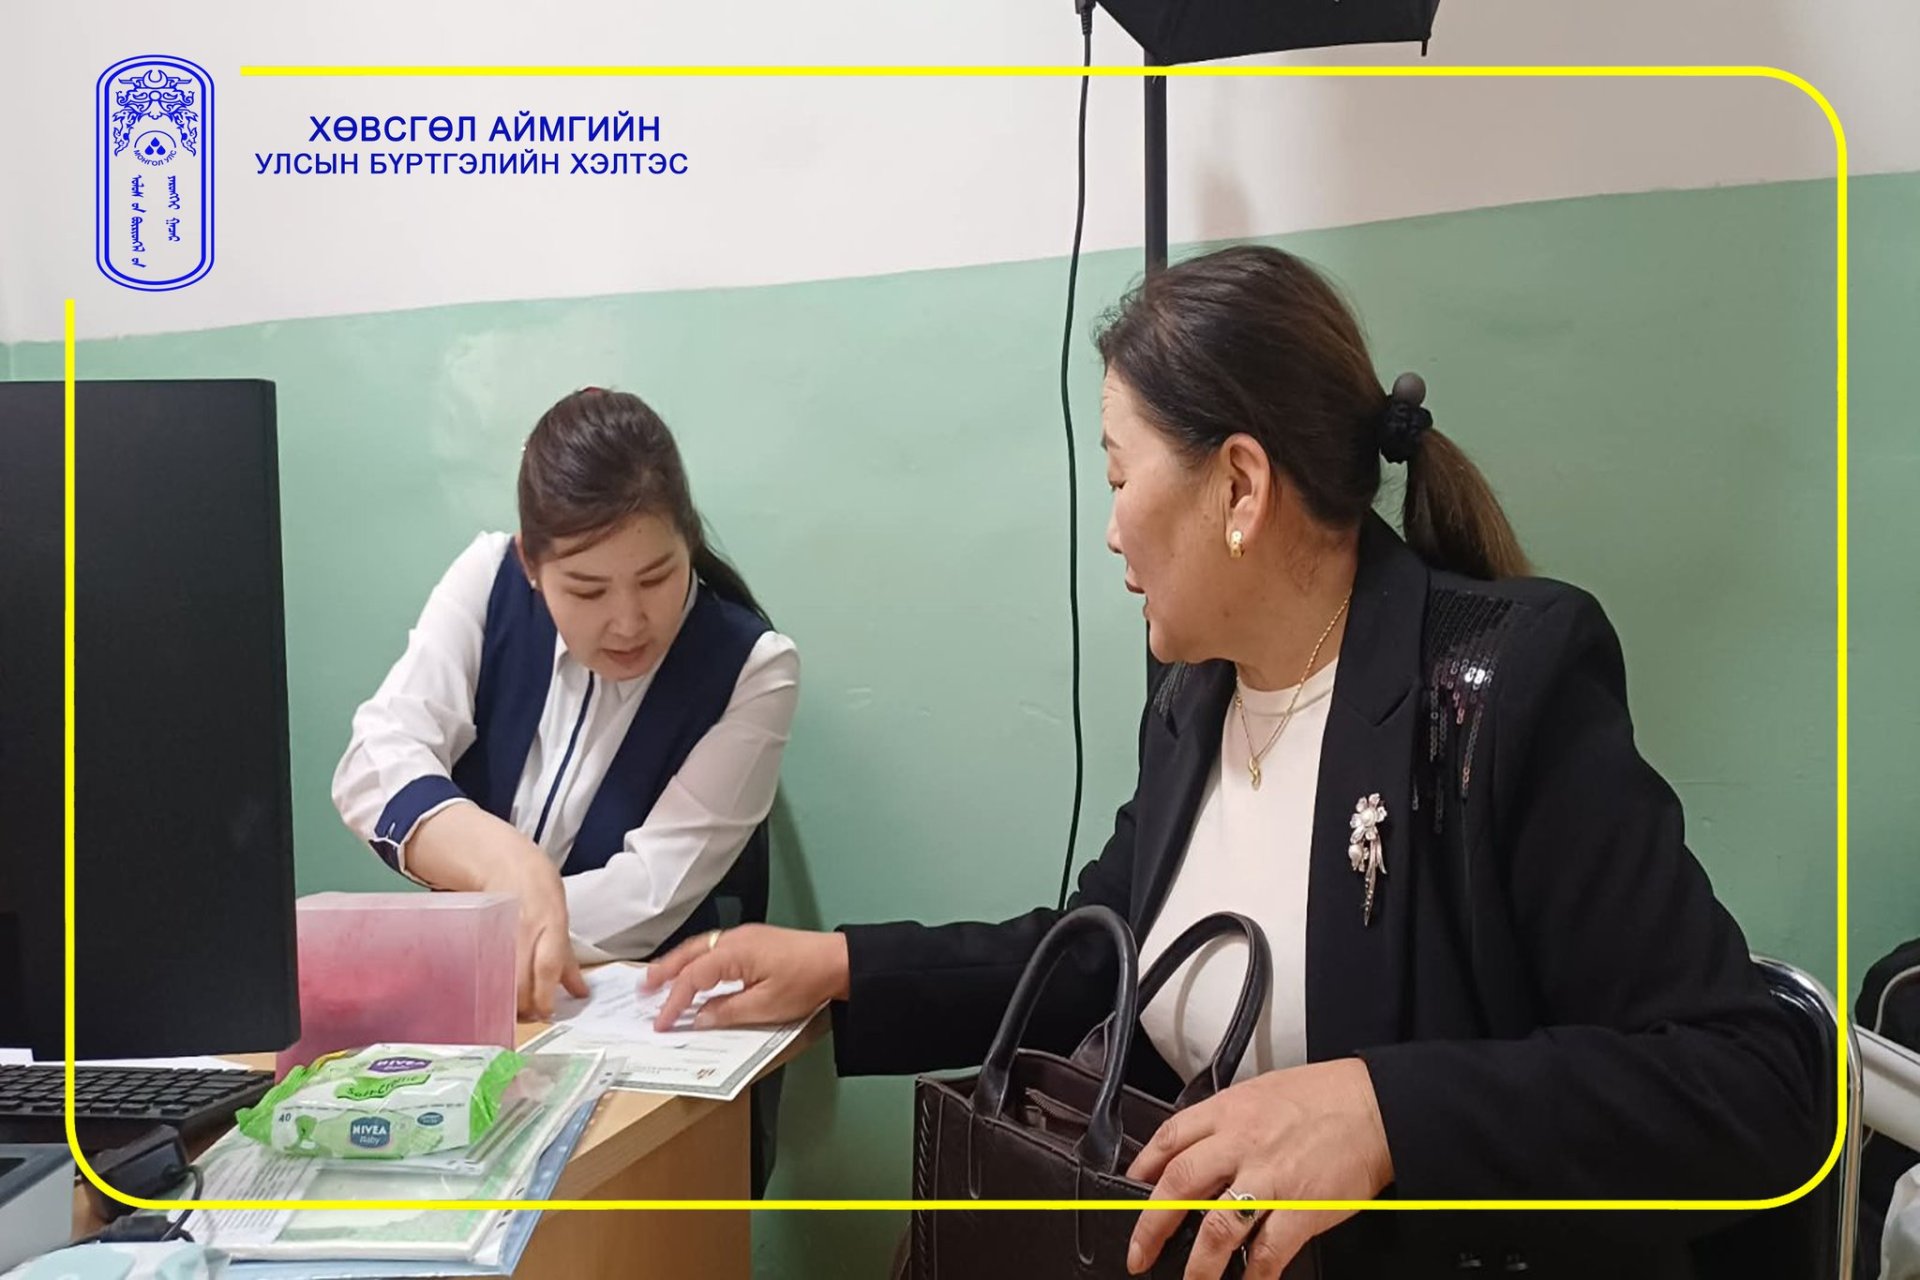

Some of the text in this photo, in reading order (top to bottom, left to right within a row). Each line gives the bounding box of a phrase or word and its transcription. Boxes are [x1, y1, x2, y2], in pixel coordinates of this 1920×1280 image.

[278, 1112, 292, 1123] 40
[352, 1124, 388, 1136] NIVEA
[359, 1135, 381, 1146] Baby
